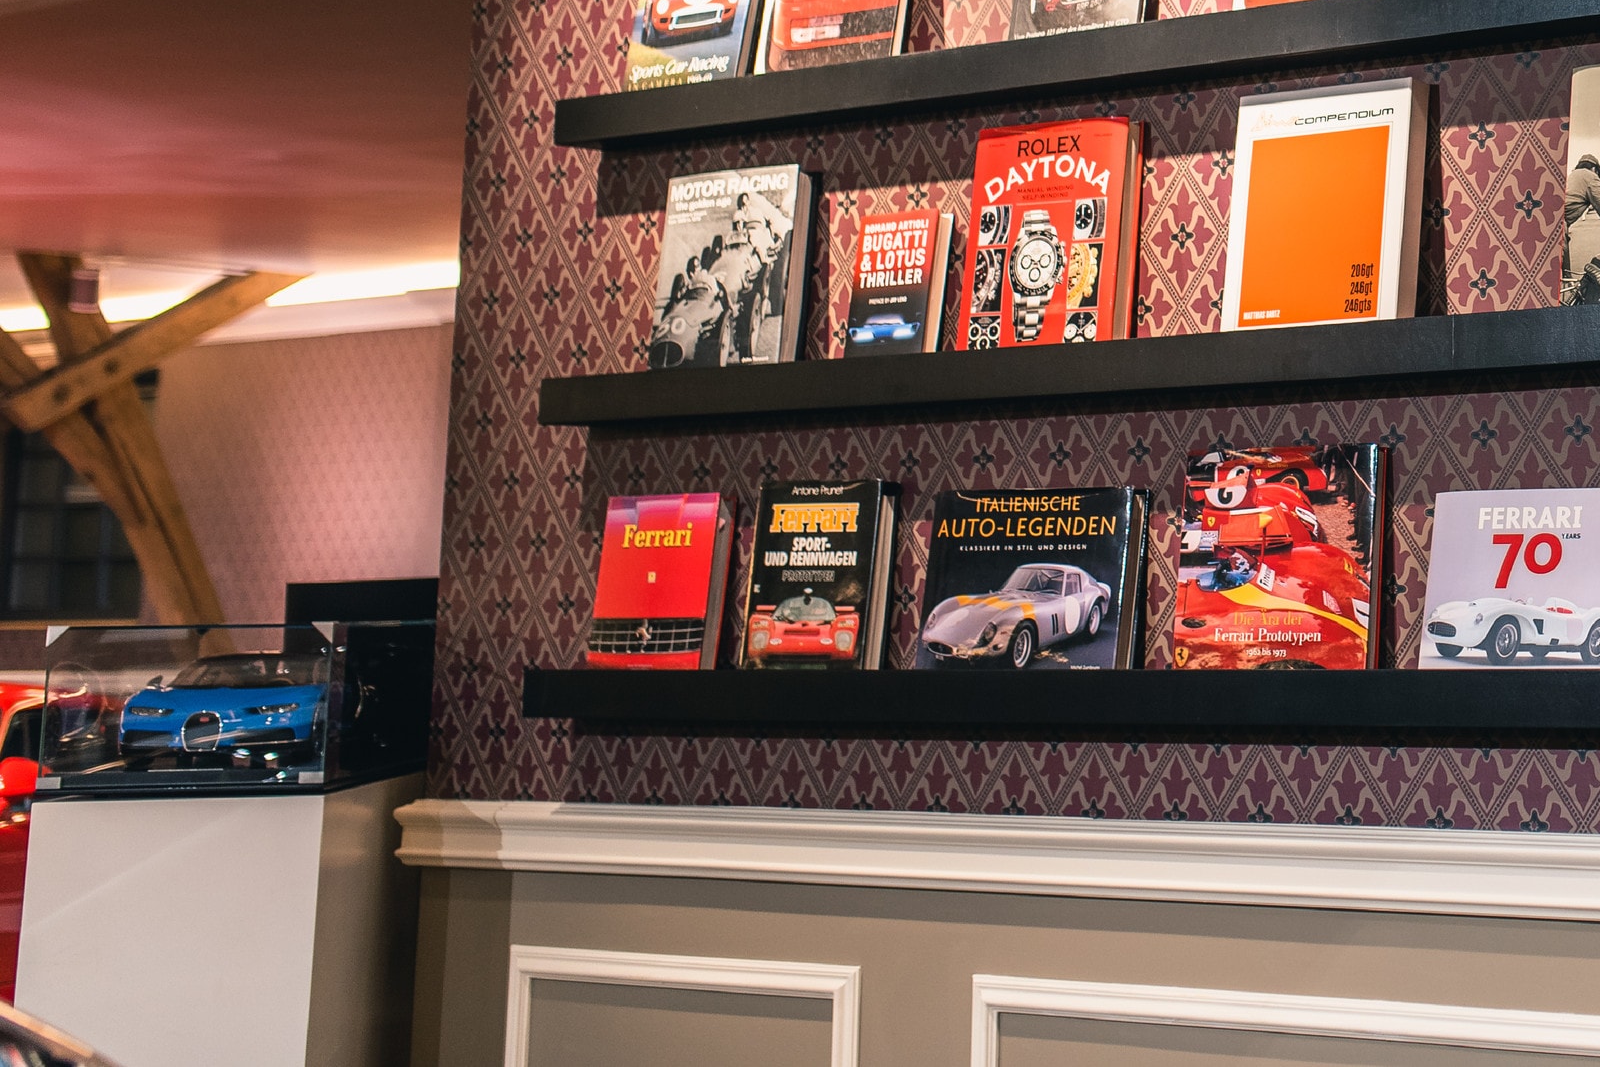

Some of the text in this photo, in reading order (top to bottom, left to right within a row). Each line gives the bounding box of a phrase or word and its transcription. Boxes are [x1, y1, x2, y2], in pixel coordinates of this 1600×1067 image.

[628, 54, 730, 84] Sports Car Racing
[1294, 107, 1394, 125] COMPENDIUM
[1017, 134, 1081, 158] ROLEX
[670, 172, 789, 202] MOTOR RACING
[984, 154, 1111, 203] DAYTONA
[1046, 184, 1074, 192] WINDING
[675, 196, 732, 211] the golden age
[865, 219, 929, 234] ROMANO ARTIOLI
[863, 230, 929, 253] BUGATTI
[860, 248, 926, 272] & LOTUS
[860, 268, 923, 289] THRILLER
[1350, 264, 1374, 278] 206gt
[1350, 282, 1373, 296] 246gt
[1344, 298, 1372, 314] 246gts
[975, 495, 1081, 513] ITALIENISCHE
[769, 502, 860, 533] Ferrari
[1478, 506, 1583, 530] FERRARI
[621, 522, 693, 549] Ferrari
[937, 516, 1117, 539] AUTO-LEGENDEN
[791, 537, 831, 552] SPORT-
[764, 551, 858, 567] UND RENNWAGEN
[1493, 532, 1563, 589] 70
[782, 569, 835, 583] PROTOTYPEN
[1233, 609, 1303, 625] Die Ära der
[1214, 627, 1321, 645] Ferrari Prototypen
[1261, 648, 1271, 656] bis
[1273, 649, 1286, 657] 1973
